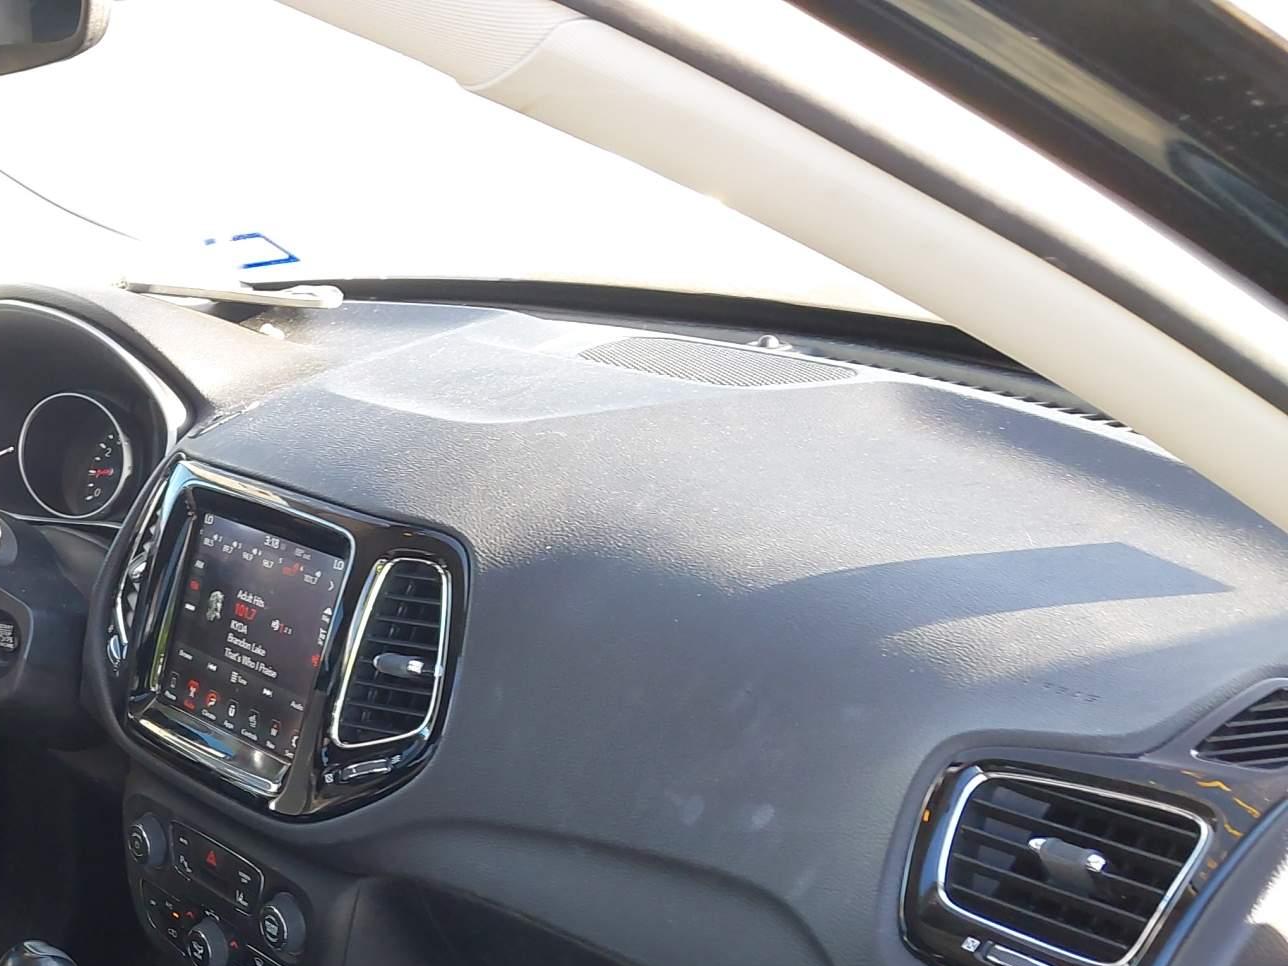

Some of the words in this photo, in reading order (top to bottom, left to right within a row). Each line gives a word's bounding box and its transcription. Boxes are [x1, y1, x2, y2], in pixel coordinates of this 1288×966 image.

[105, 447, 112, 457] 2
[94, 488, 101, 497] 0
[237, 590, 253, 604] Adult
[253, 596, 265, 608] Hits
[226, 632, 252, 650] Brandon
[251, 642, 266, 656] Lake
[224, 647, 241, 662] That's
[241, 655, 256, 668] Who
[258, 662, 278, 678] Praise
